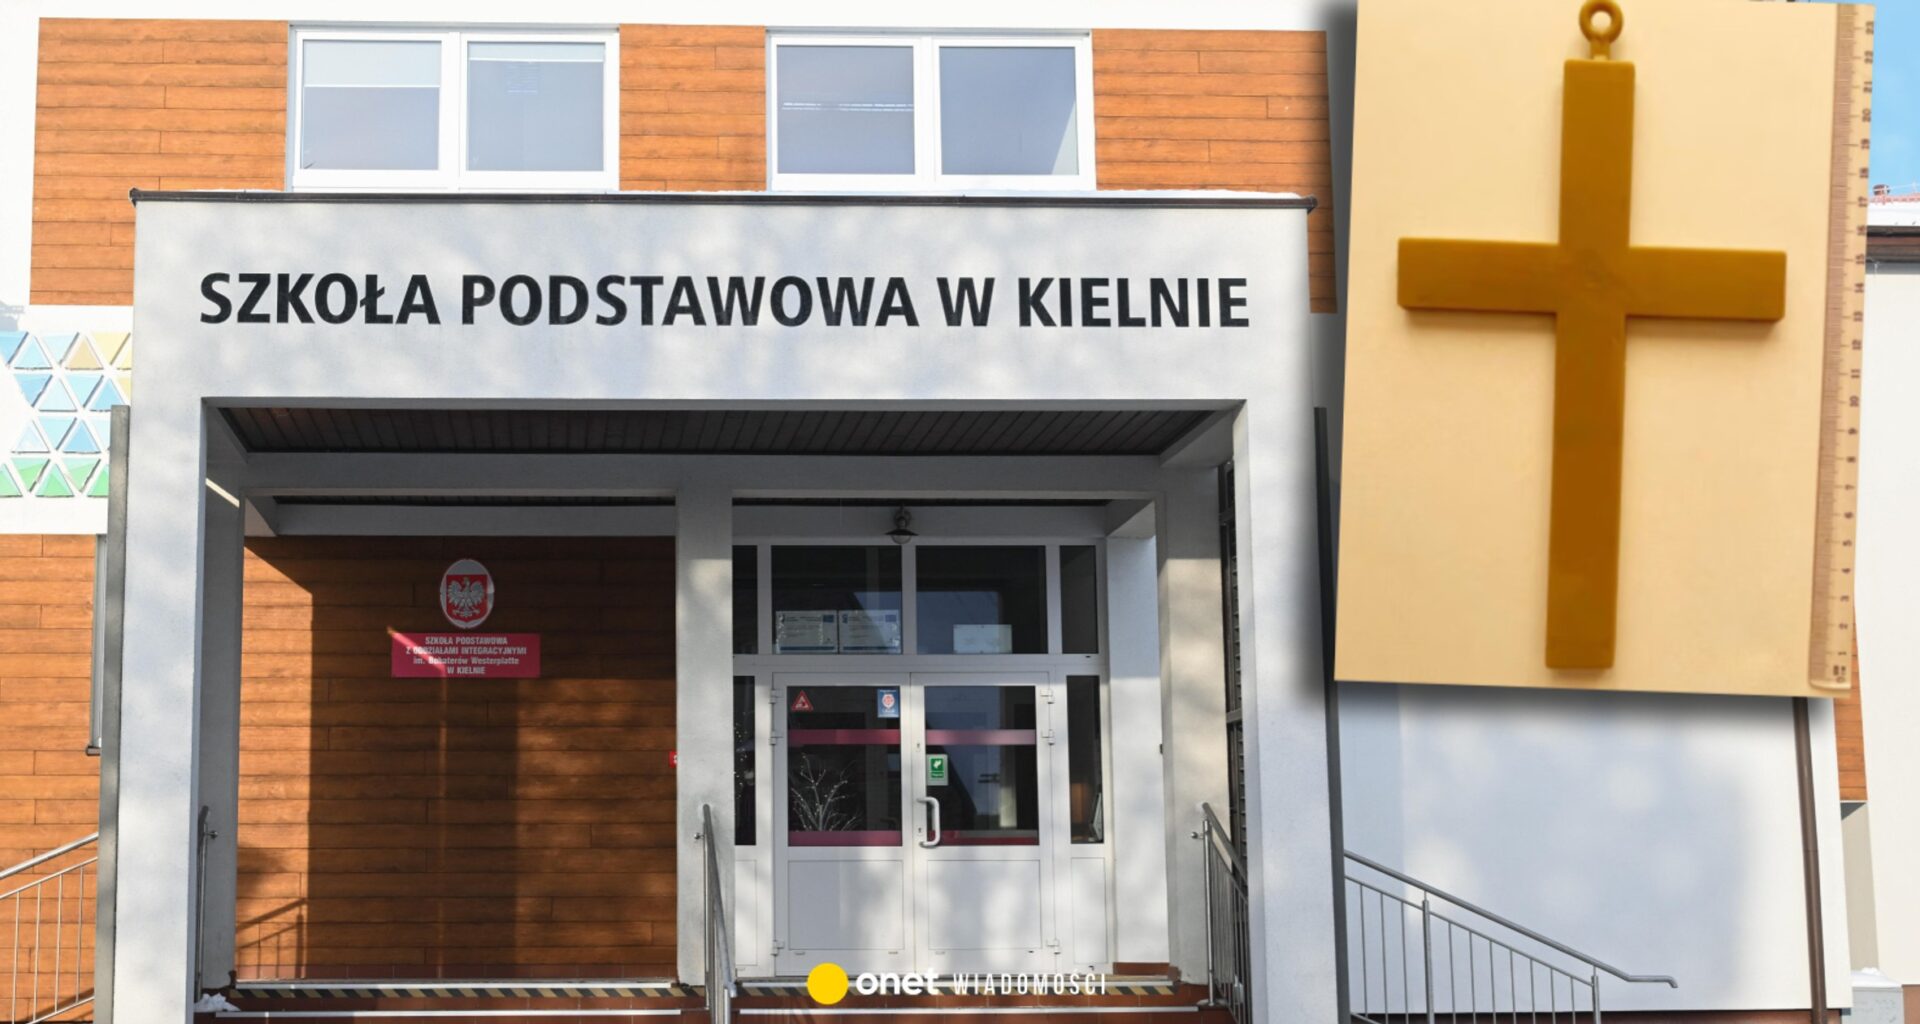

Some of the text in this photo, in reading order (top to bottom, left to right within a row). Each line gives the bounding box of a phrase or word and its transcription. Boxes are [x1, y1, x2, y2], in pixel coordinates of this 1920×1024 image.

[200, 272, 1250, 328] SZKOŁA PODSTAWOWA W KIELNIE
[425, 636, 508, 645] SZKOŁA PODSTAWOWA
[461, 646, 527, 655] INTEGRACYJNYMI
[447, 666, 486, 675] W KIELNIE
